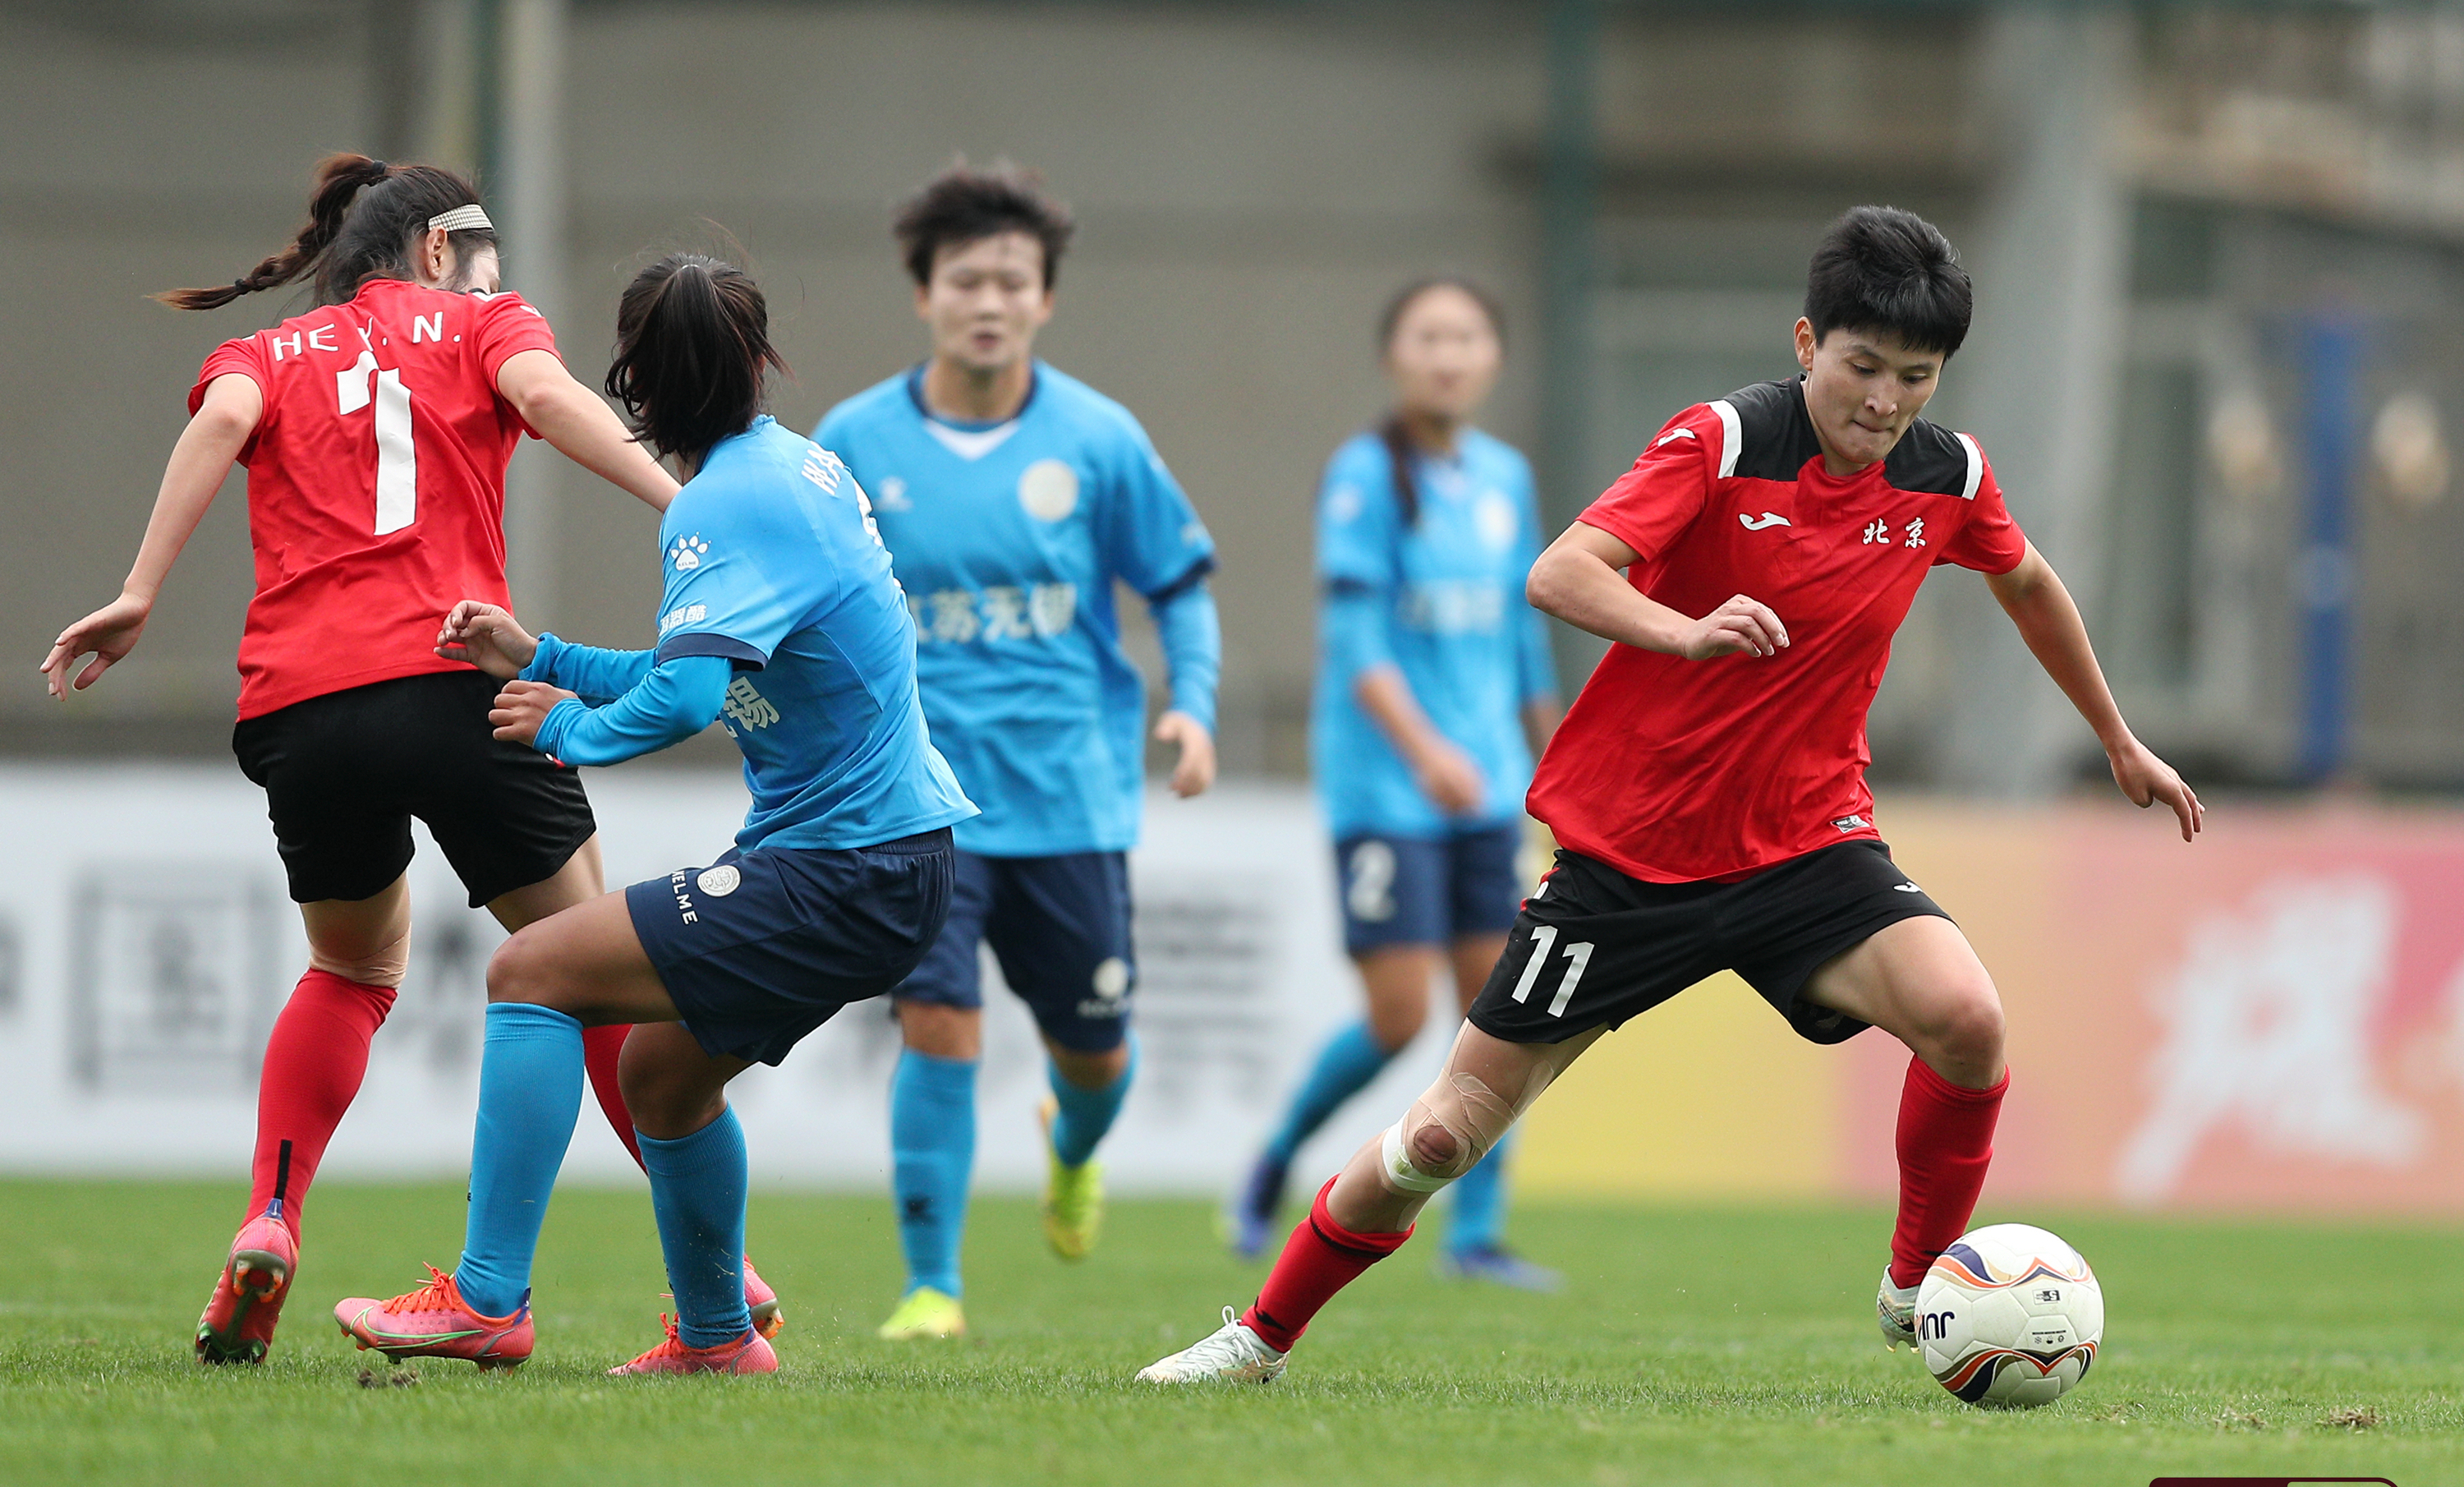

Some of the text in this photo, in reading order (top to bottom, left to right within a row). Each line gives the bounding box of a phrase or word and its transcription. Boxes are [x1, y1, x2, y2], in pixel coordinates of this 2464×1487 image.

[272, 323, 339, 361] HE
[412, 311, 462, 344] N.
[1863, 517, 1927, 549] 北京
[671, 870, 699, 925] KELME
[1511, 925, 1595, 1018] 11
